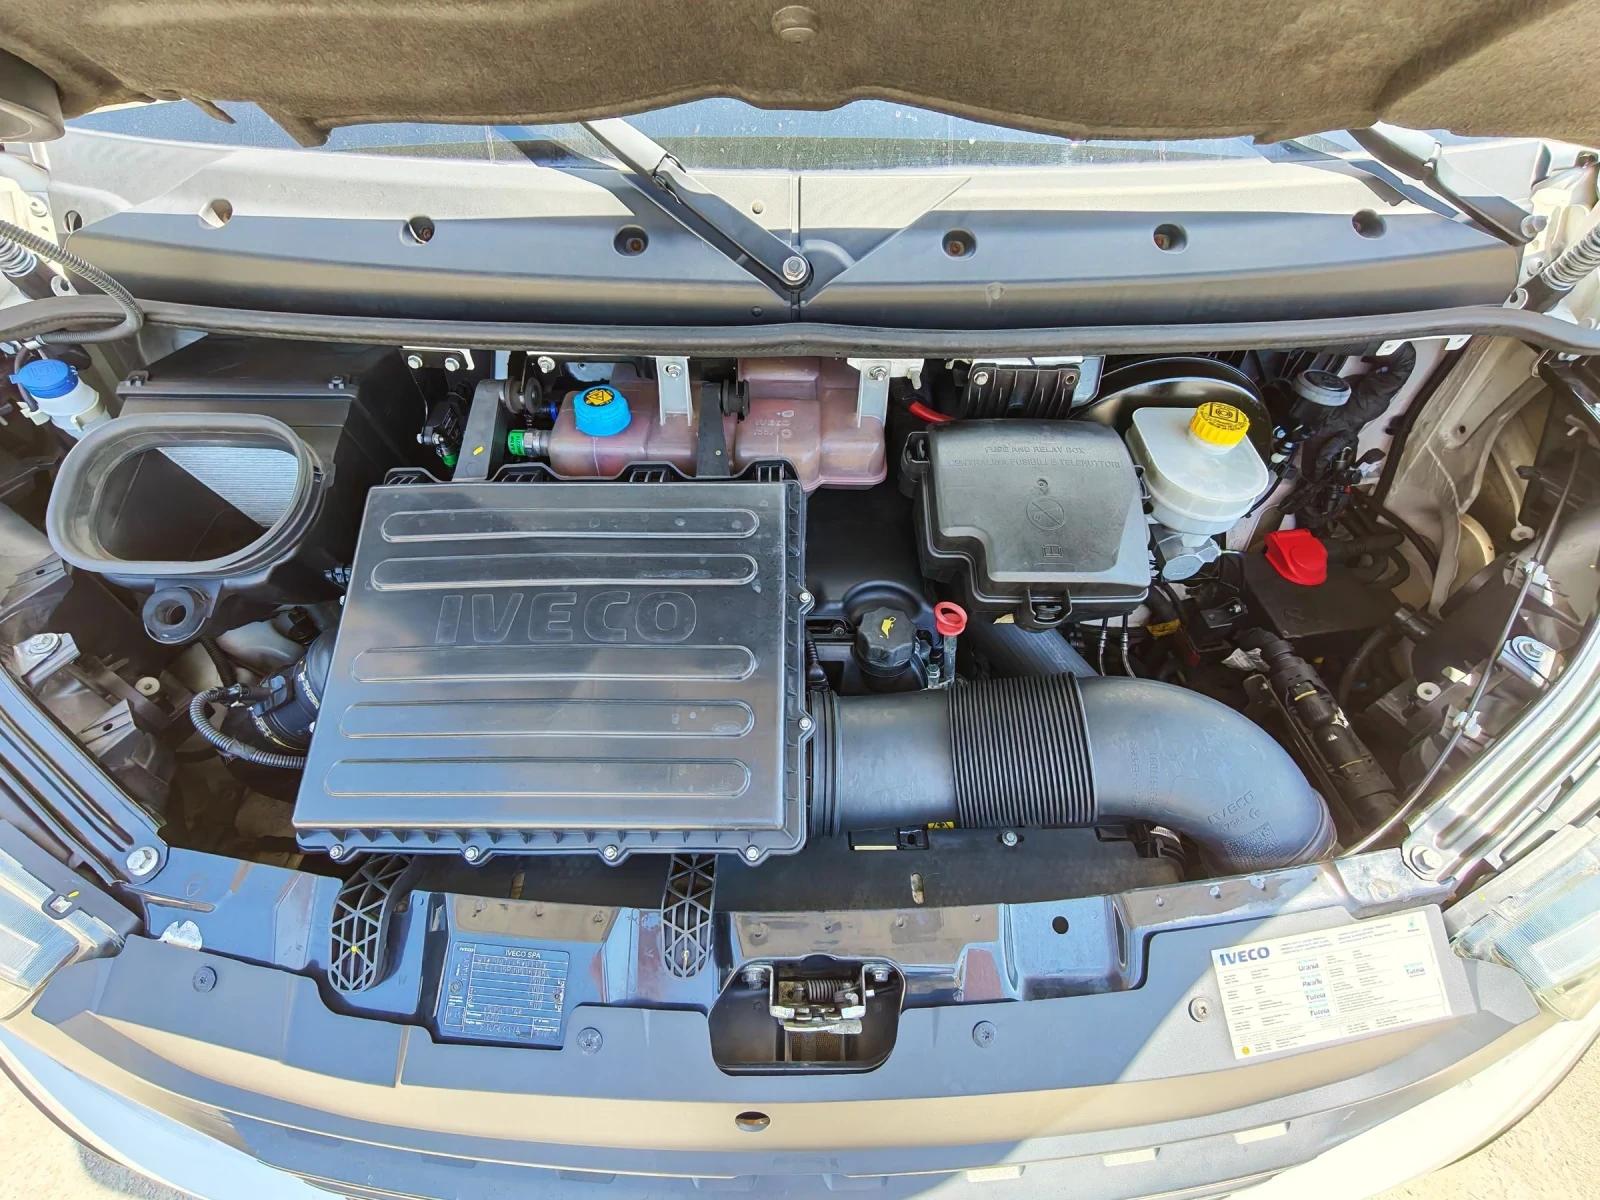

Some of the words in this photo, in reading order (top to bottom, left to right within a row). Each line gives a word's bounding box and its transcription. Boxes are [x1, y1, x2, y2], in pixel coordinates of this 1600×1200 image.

[1066, 446, 1085, 454] BOX
[949, 459, 1009, 467] CENTRALINA
[1010, 459, 1048, 467] FUSIBILI
[435, 590, 697, 643] IVECO
[1207, 789, 1254, 825] IVECO
[505, 949, 527, 957] IVECO
[527, 951, 541, 959] SPA
[1219, 946, 1270, 967] IVECO
